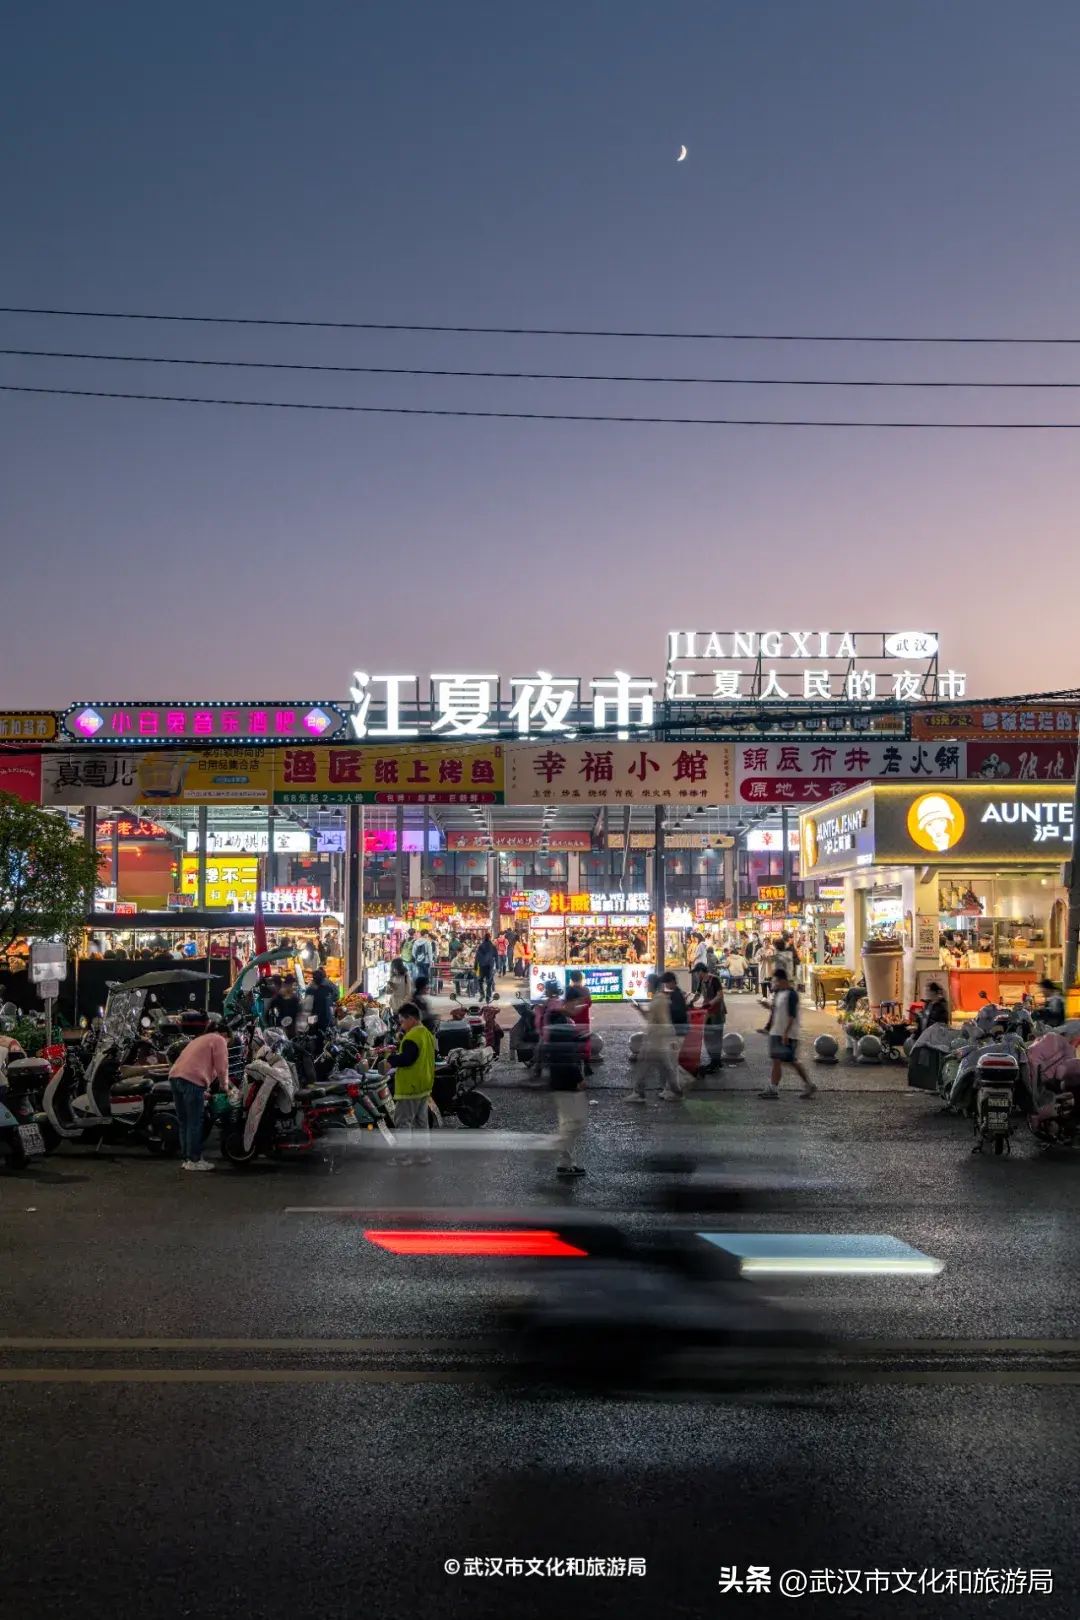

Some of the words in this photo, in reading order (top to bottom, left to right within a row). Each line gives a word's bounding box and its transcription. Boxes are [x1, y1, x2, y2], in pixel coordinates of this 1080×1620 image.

[668, 631, 858, 663] JIANGXIA
[895, 637, 929, 652] 武汉
[666, 670, 967, 700] 江夏人民的夜市
[350, 670, 658, 740] 江夏夜市
[112, 711, 295, 734] 小白兔音乐酒吧
[284, 750, 362, 784] 渔匠
[375, 759, 495, 784] 纸上烤鱼
[533, 750, 709, 784] 幸福小館
[749, 781, 852, 798] 原地大夜
[980, 803, 1074, 823] AUNTE
